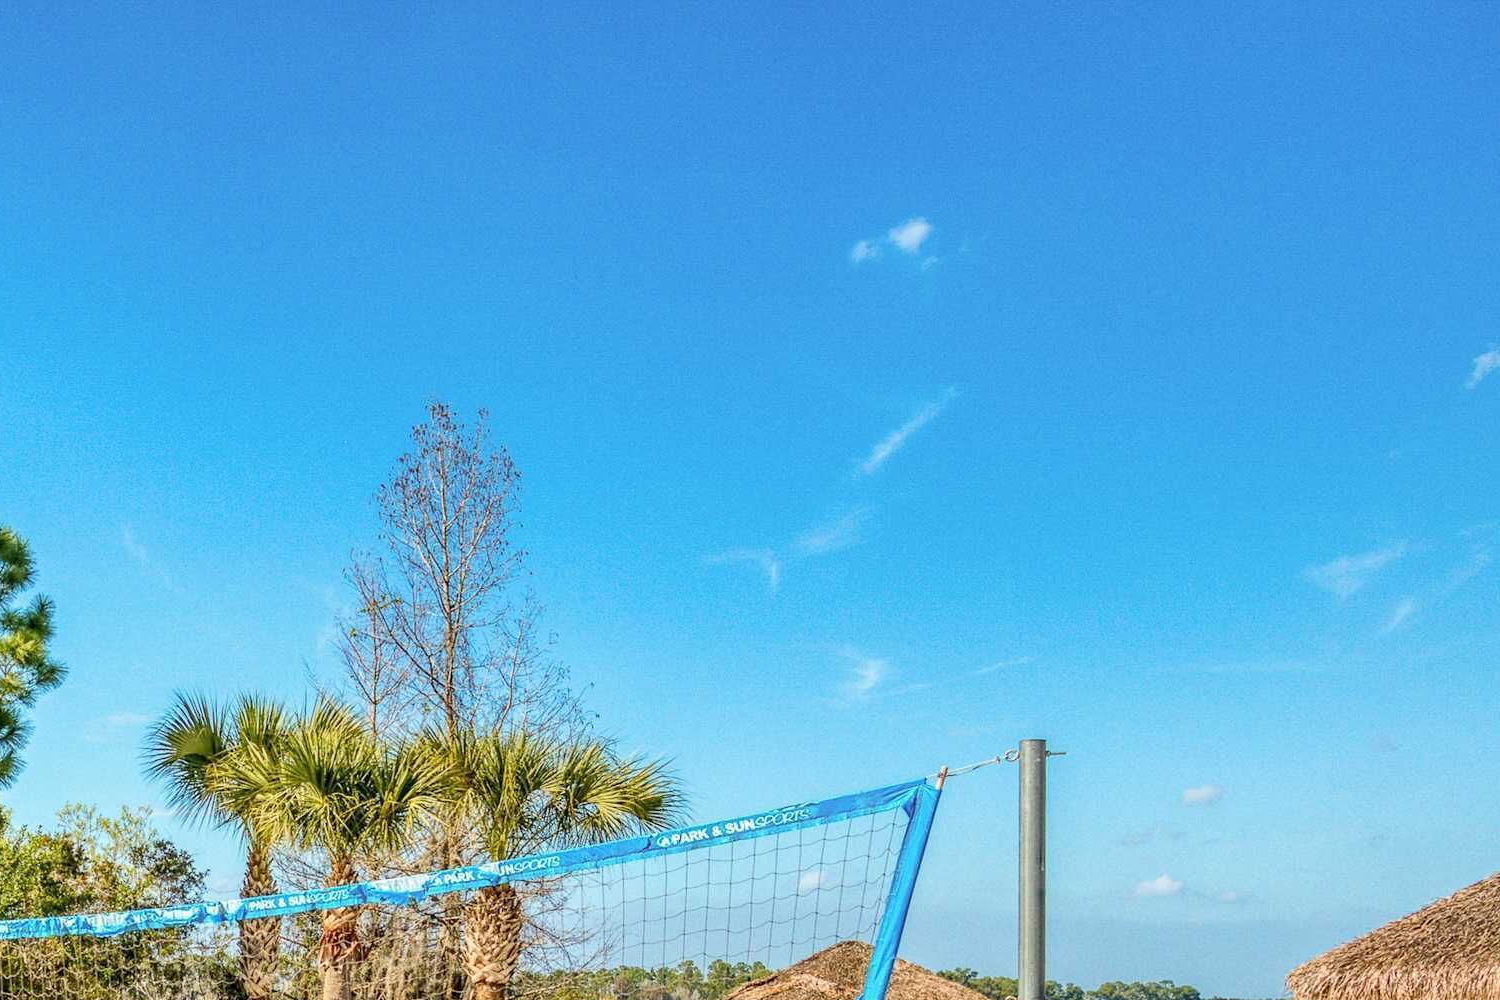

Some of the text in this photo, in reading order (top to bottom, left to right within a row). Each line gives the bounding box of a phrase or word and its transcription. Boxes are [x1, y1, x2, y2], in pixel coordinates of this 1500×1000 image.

[672, 830, 709, 846] PARK
[712, 825, 722, 836] &
[443, 869, 475, 884] PARK
[249, 899, 276, 912] PARK
[278, 896, 286, 907] &
